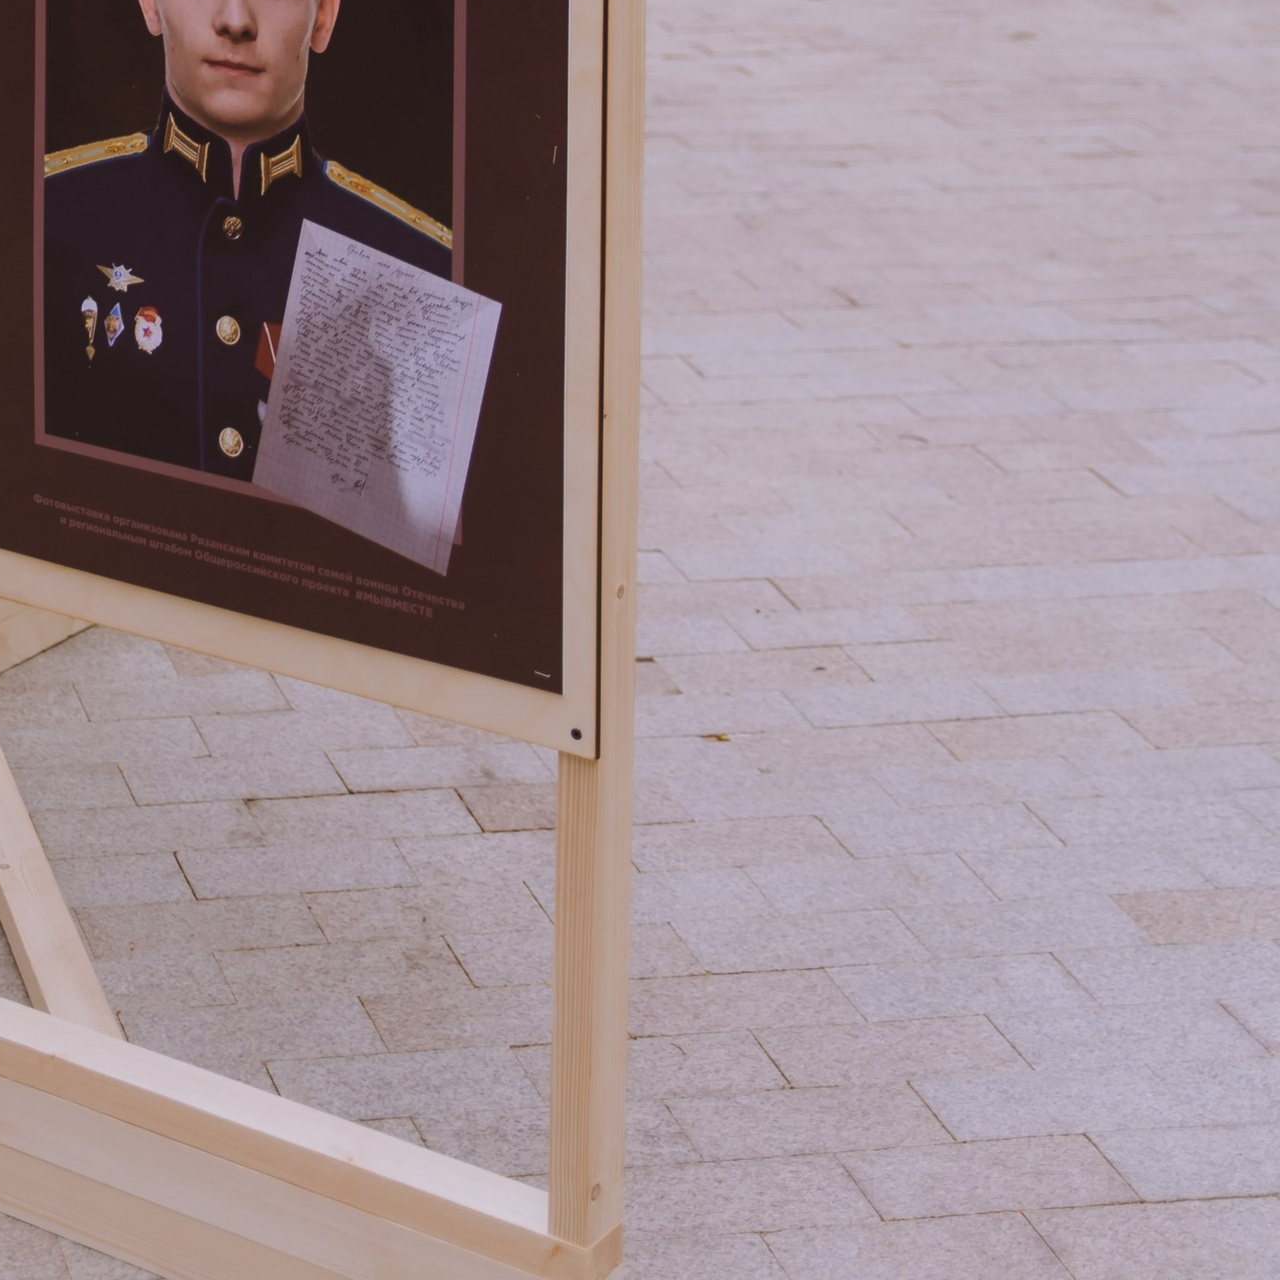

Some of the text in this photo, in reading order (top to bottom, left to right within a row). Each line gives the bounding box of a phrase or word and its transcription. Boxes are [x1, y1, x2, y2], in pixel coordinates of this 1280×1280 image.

[32, 492, 465, 610] Фотовыставка организована Рязанским комитетом семей воинов Отечества
[59, 515, 67, 525] и
[68, 518, 147, 546] региональным
[148, 539, 192, 557] штабом
[194, 549, 299, 584] Общероссийского
[301, 577, 349, 597] проекта
